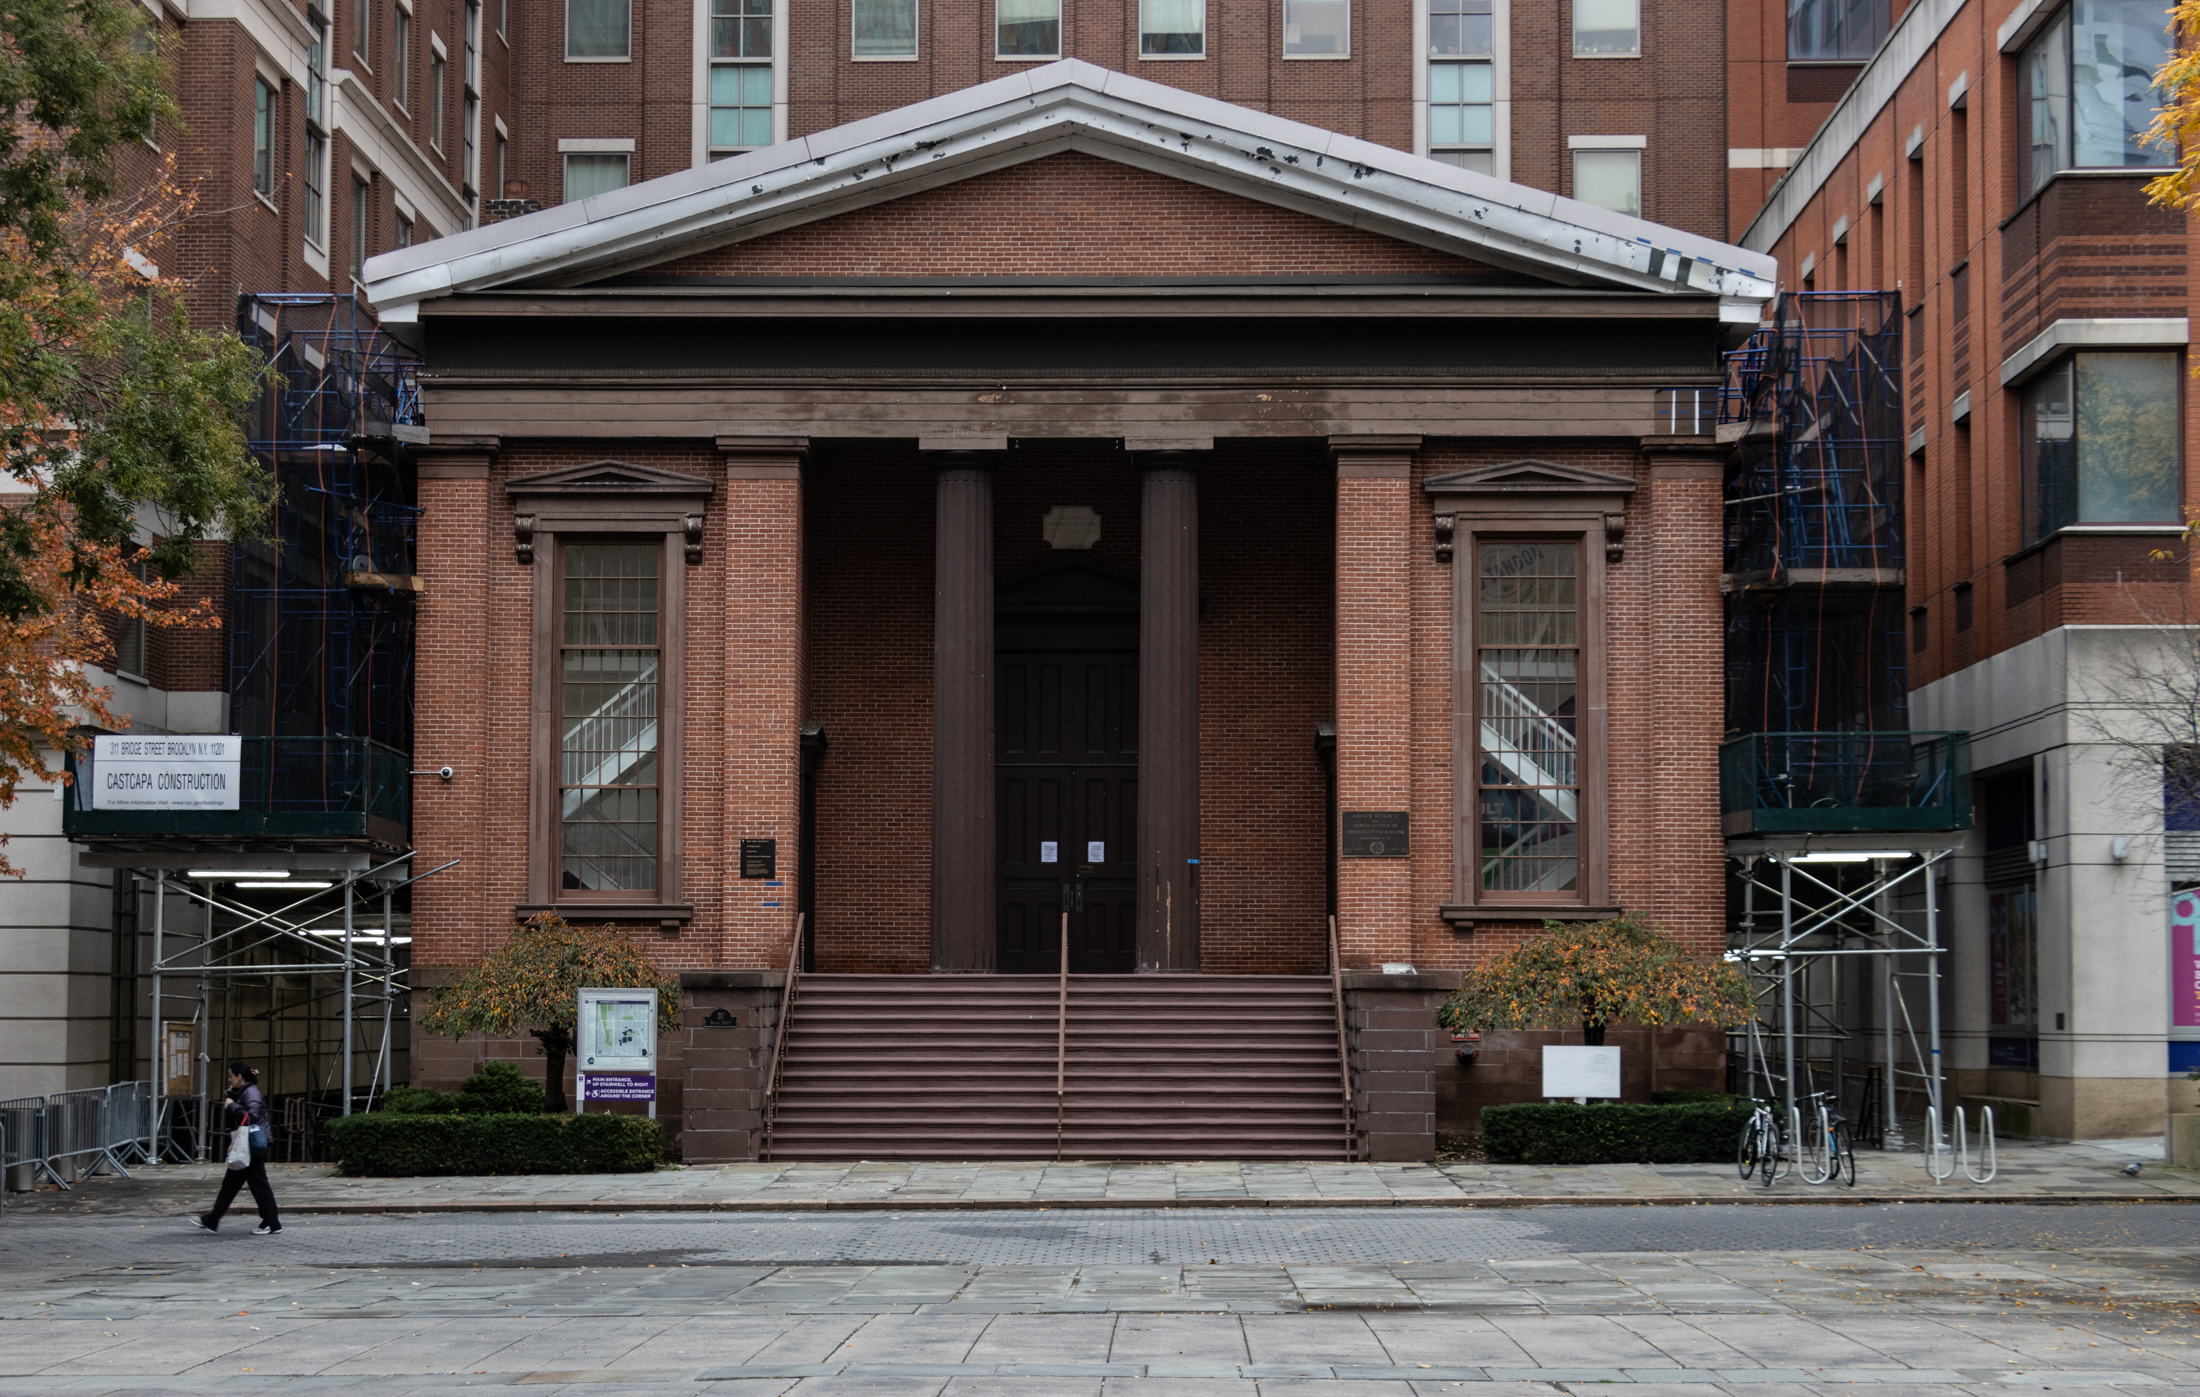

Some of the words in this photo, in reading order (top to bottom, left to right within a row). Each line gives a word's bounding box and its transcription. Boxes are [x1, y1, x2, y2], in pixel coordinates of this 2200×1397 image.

[1485, 546, 1545, 583] TANDON
[110, 742, 119, 755] 311
[121, 742, 142, 755] BRIDGE
[144, 742, 166, 755] STREET
[167, 742, 196, 755] BROOKLYN
[210, 742, 225, 755] 11201
[107, 773, 153, 790] CASTCAPA
[157, 773, 226, 790] CONSTRUCTION
[172, 799, 225, 807] www.nyc.gov/buildings
[1491, 817, 1512, 829] TO
